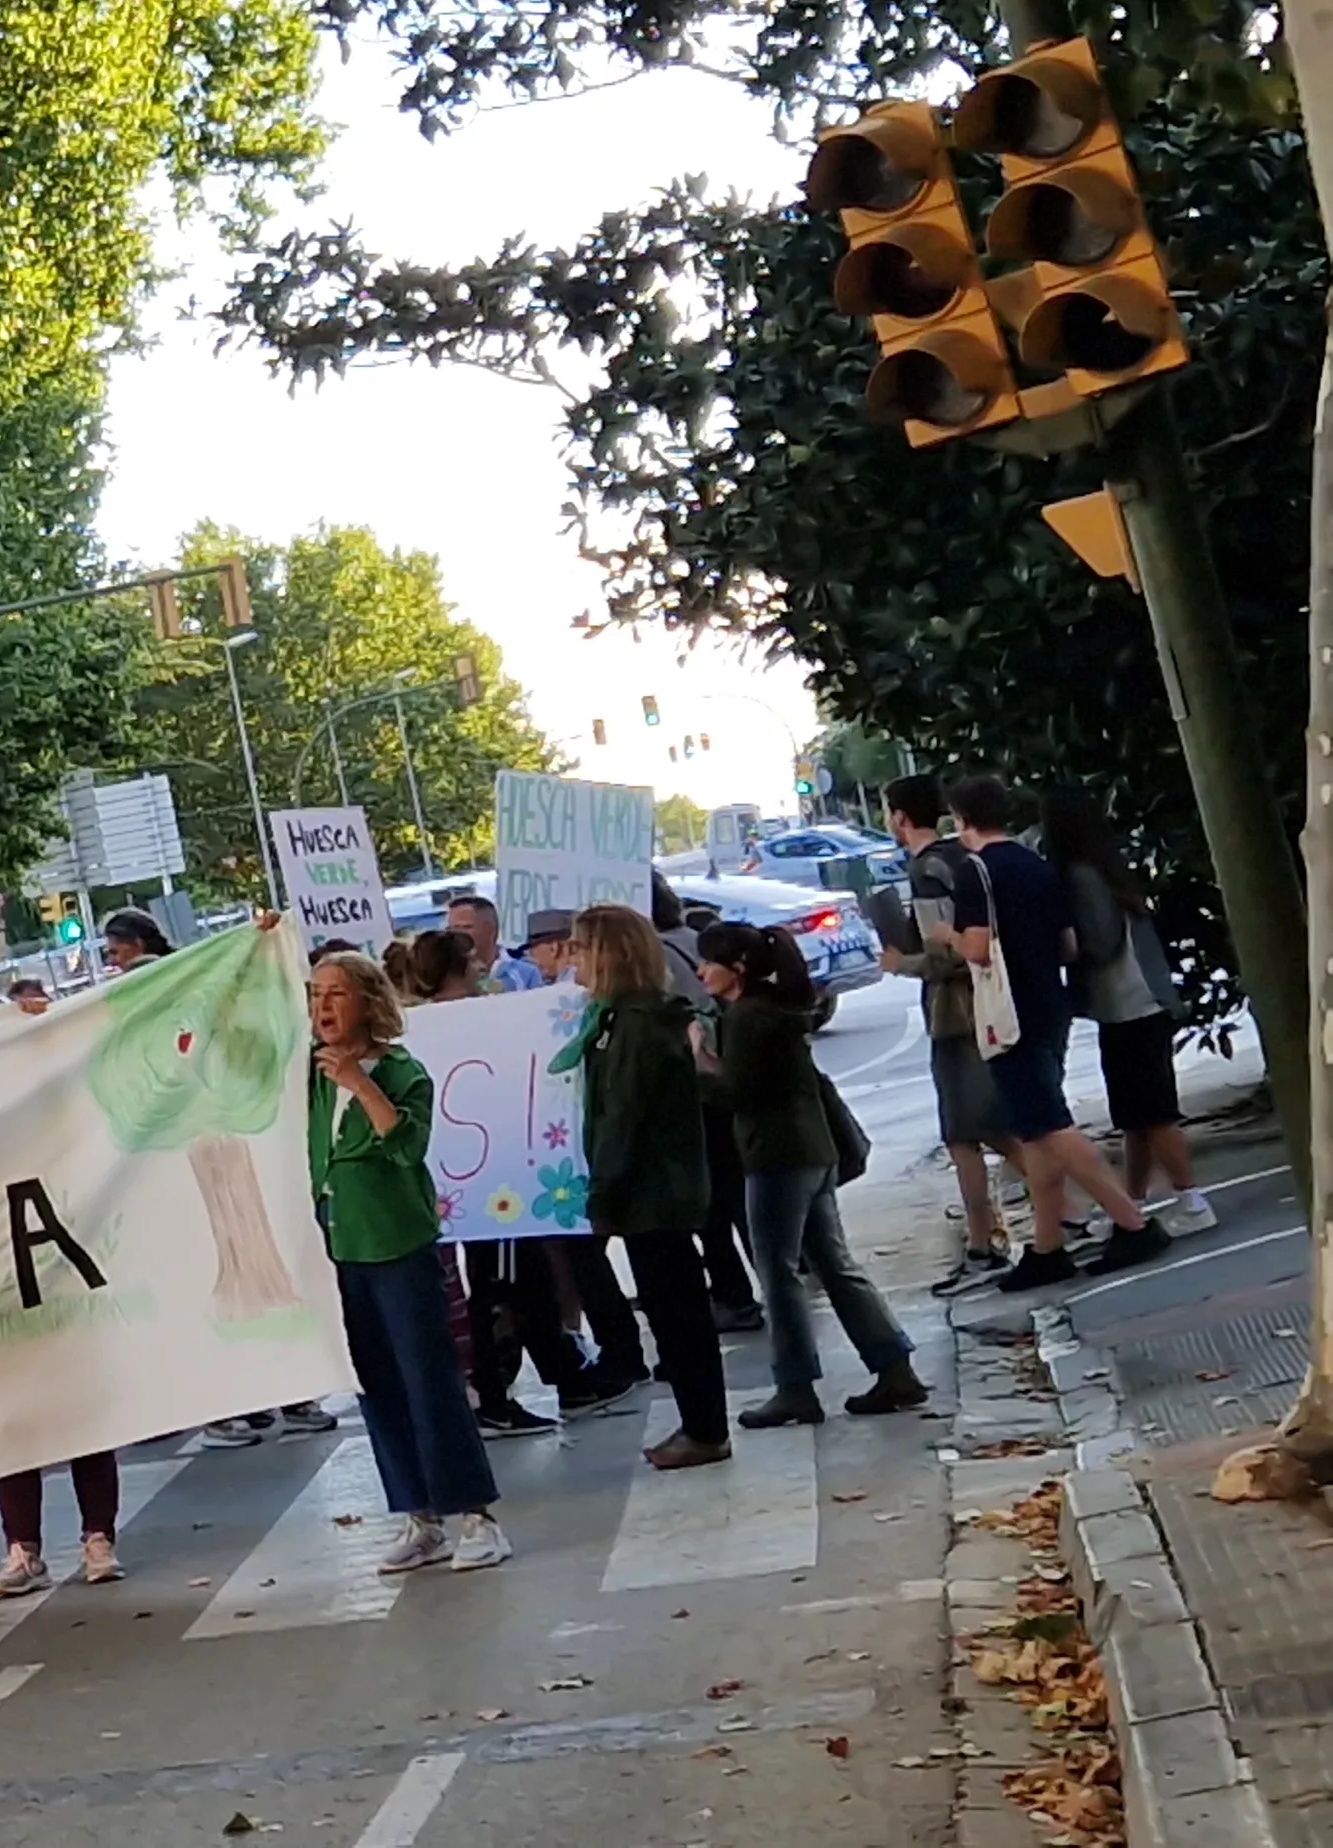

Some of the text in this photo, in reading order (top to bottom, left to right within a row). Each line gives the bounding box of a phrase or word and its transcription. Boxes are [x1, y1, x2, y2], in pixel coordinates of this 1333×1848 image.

[498, 773, 653, 865] HUESCA VERDE
[286, 820, 360, 857] HUESCA
[298, 895, 374, 926] HUESCA
